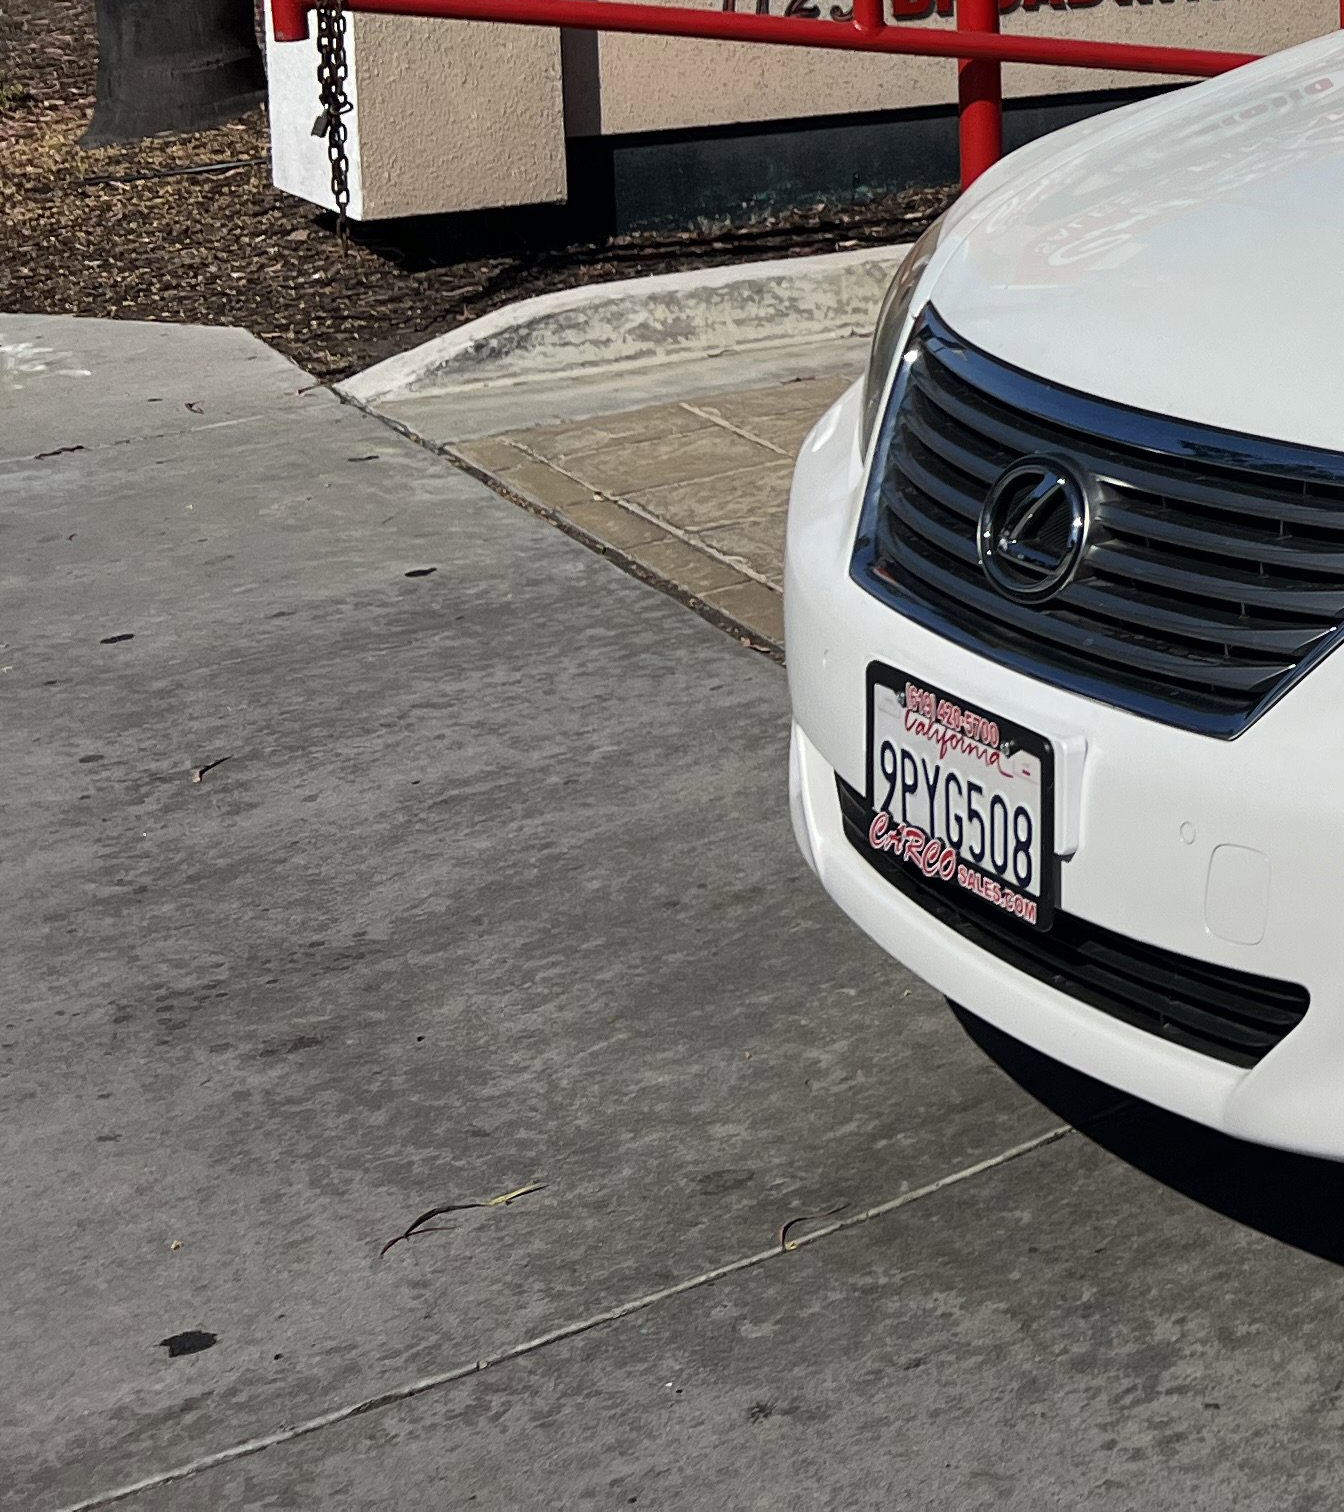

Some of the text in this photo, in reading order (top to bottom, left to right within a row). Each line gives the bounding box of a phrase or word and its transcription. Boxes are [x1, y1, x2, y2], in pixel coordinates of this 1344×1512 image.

[904, 708, 1013, 778] California
[905, 681, 937, 721] (619)
[879, 739, 1033, 889] 9PYG508
[869, 811, 1037, 925] CARCO SALES.COM
